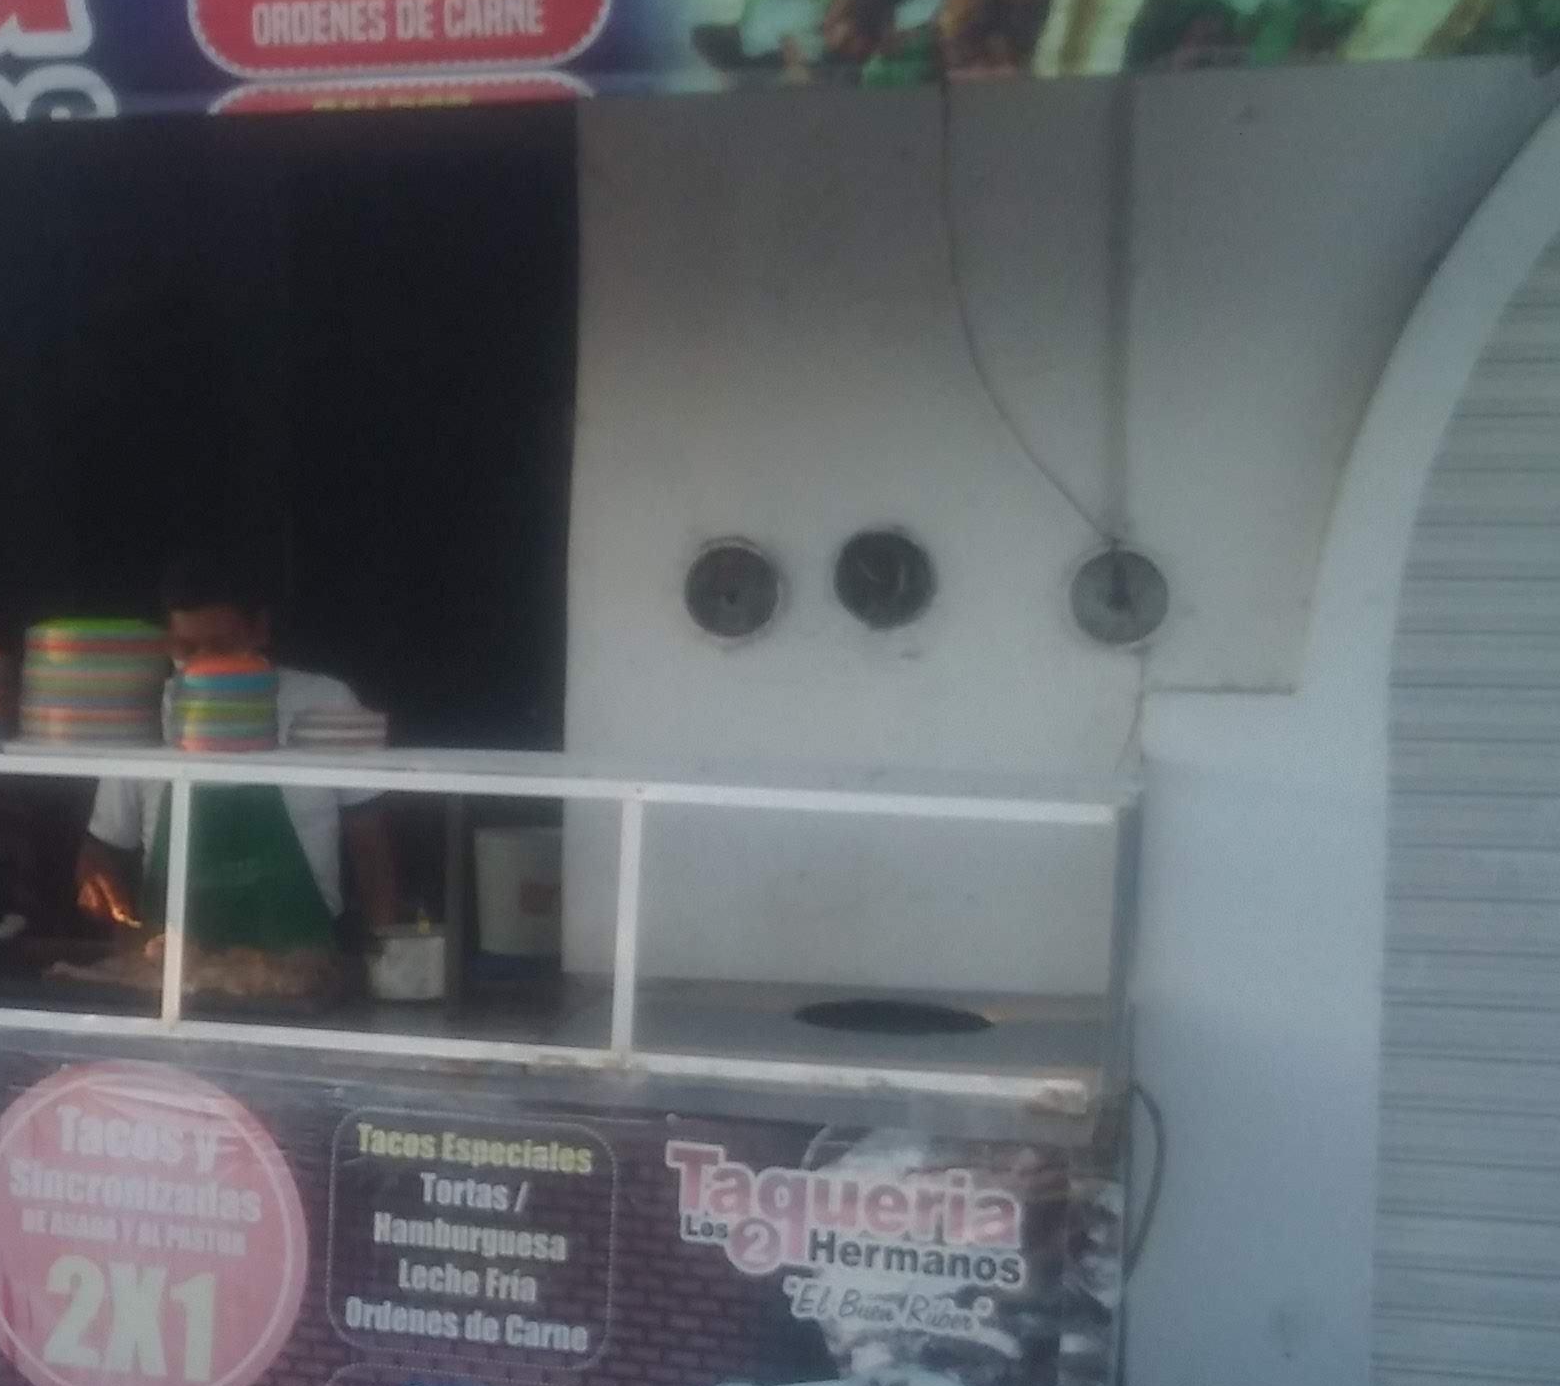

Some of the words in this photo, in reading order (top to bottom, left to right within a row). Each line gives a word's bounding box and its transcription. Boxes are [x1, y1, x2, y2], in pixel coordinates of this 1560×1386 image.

[56, 1104, 184, 1167] Tacos
[357, 1122, 436, 1160] Tacos
[441, 1129, 593, 1175] Especiales
[420, 1171, 509, 1211] Tortas
[668, 1143, 1023, 1259] Taqueria
[373, 1212, 568, 1263] Hamburguesa
[686, 1216, 728, 1238] Los
[809, 1228, 1022, 1285] Hermanos
[398, 1258, 479, 1296] Leche
[46, 1254, 217, 1382] 2X1
[345, 1296, 459, 1340] Ordenes
[465, 1310, 500, 1345] de
[505, 1313, 589, 1353] Carne
